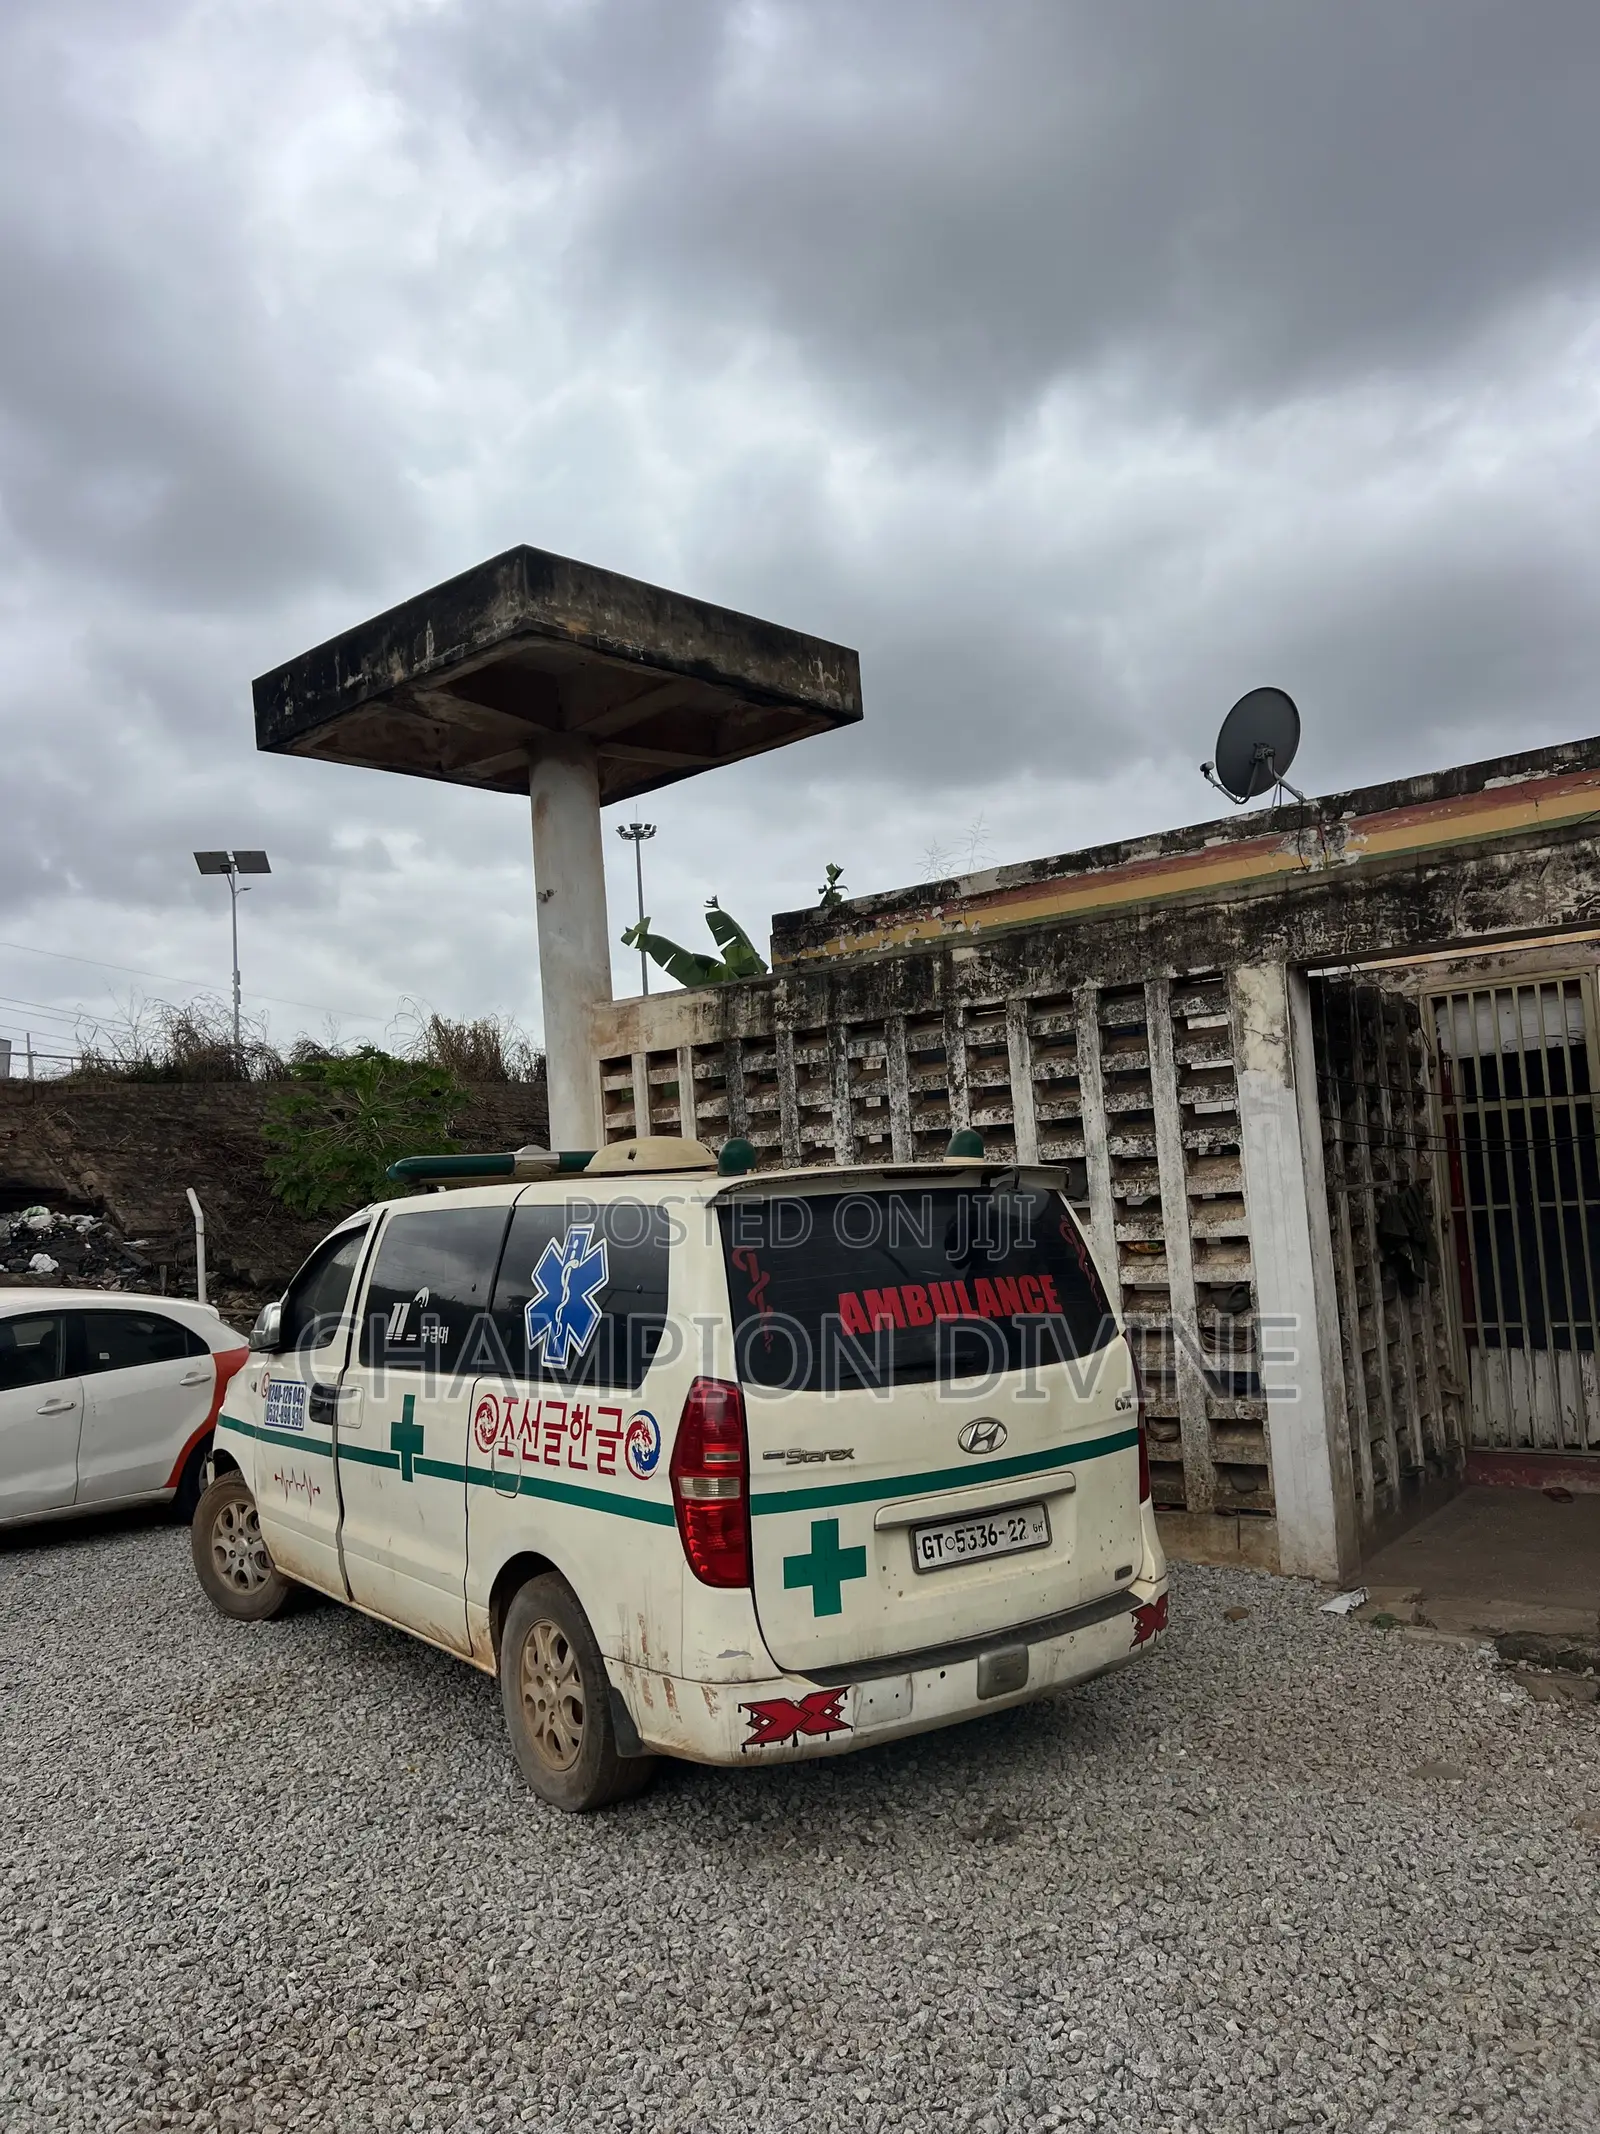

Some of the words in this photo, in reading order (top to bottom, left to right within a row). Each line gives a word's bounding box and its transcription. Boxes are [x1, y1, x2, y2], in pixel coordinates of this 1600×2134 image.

[838, 1274, 1063, 1336] AMBULANCE
[421, 1325, 449, 1344] 구급대
[498, 1396, 624, 1476] 조선글한글
[785, 1447, 855, 1466] Starex
[921, 1533, 943, 1560] GT
[954, 1517, 1028, 1553] 5336-22
